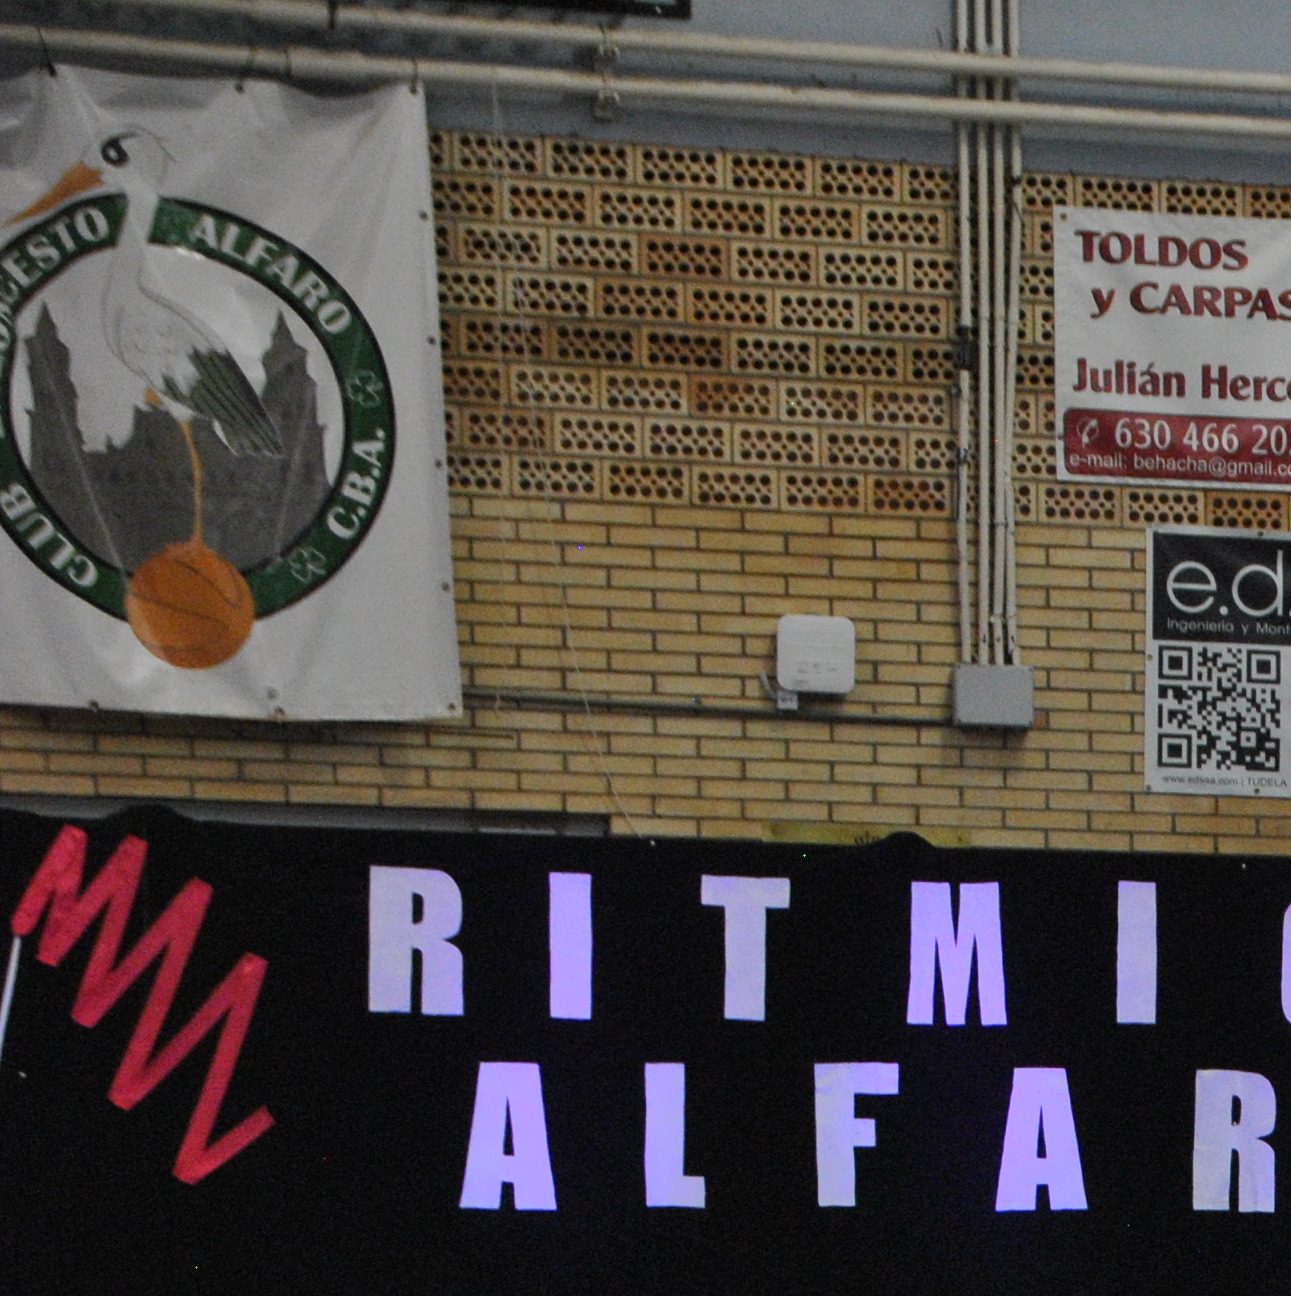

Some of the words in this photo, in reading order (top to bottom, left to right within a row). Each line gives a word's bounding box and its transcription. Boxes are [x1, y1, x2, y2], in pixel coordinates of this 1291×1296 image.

[1074, 229, 1249, 271] TOLDOS
[190, 214, 352, 335] ALFARO
[1090, 287, 1115, 319] y
[1073, 357, 1186, 398] Julián
[1115, 417, 1171, 450] 630
[1183, 422, 1240, 453] 466
[1069, 453, 1128, 469] e-mail:
[328, 428, 387, 540] C.B.A.
[0, 482, 98, 588] CLUB
[1241, 623, 1250, 634] y
[1246, 777, 1288, 788] TUDELA
